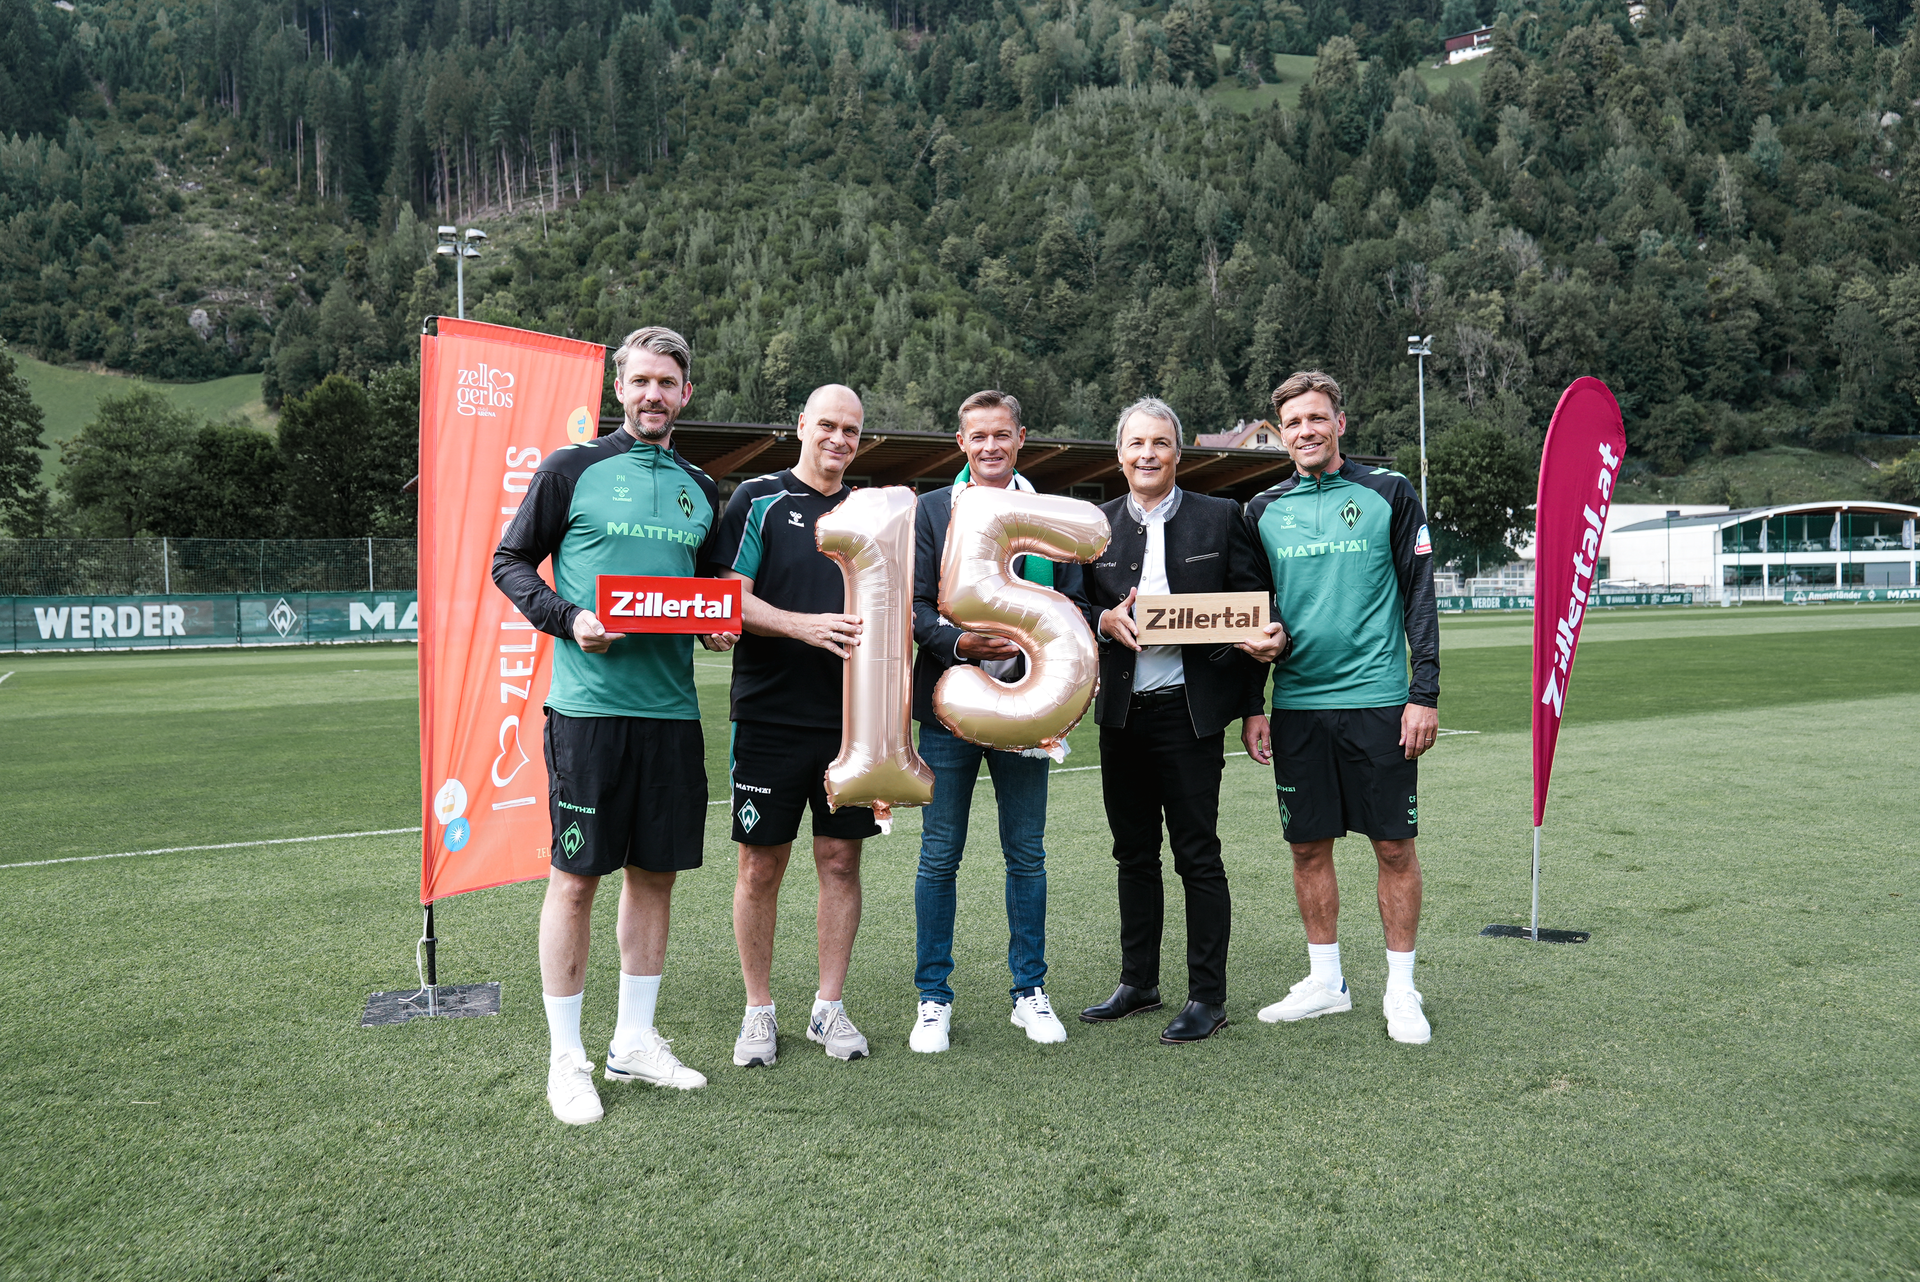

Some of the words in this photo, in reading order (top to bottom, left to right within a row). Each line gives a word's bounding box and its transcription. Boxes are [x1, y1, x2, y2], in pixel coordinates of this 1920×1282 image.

[458, 363, 488, 387] zell
[457, 382, 514, 416] gerlos
[607, 522, 700, 548] MATTHÄI
[1277, 539, 1368, 559] MATTHÄI
[1541, 442, 1619, 718] Zillertal.at
[609, 591, 733, 618] Zillertal
[1471, 597, 1500, 609] WERDER
[1808, 590, 1862, 600] Ammerländer
[34, 604, 186, 639] WERDER
[1145, 606, 1260, 630] Zillertal
